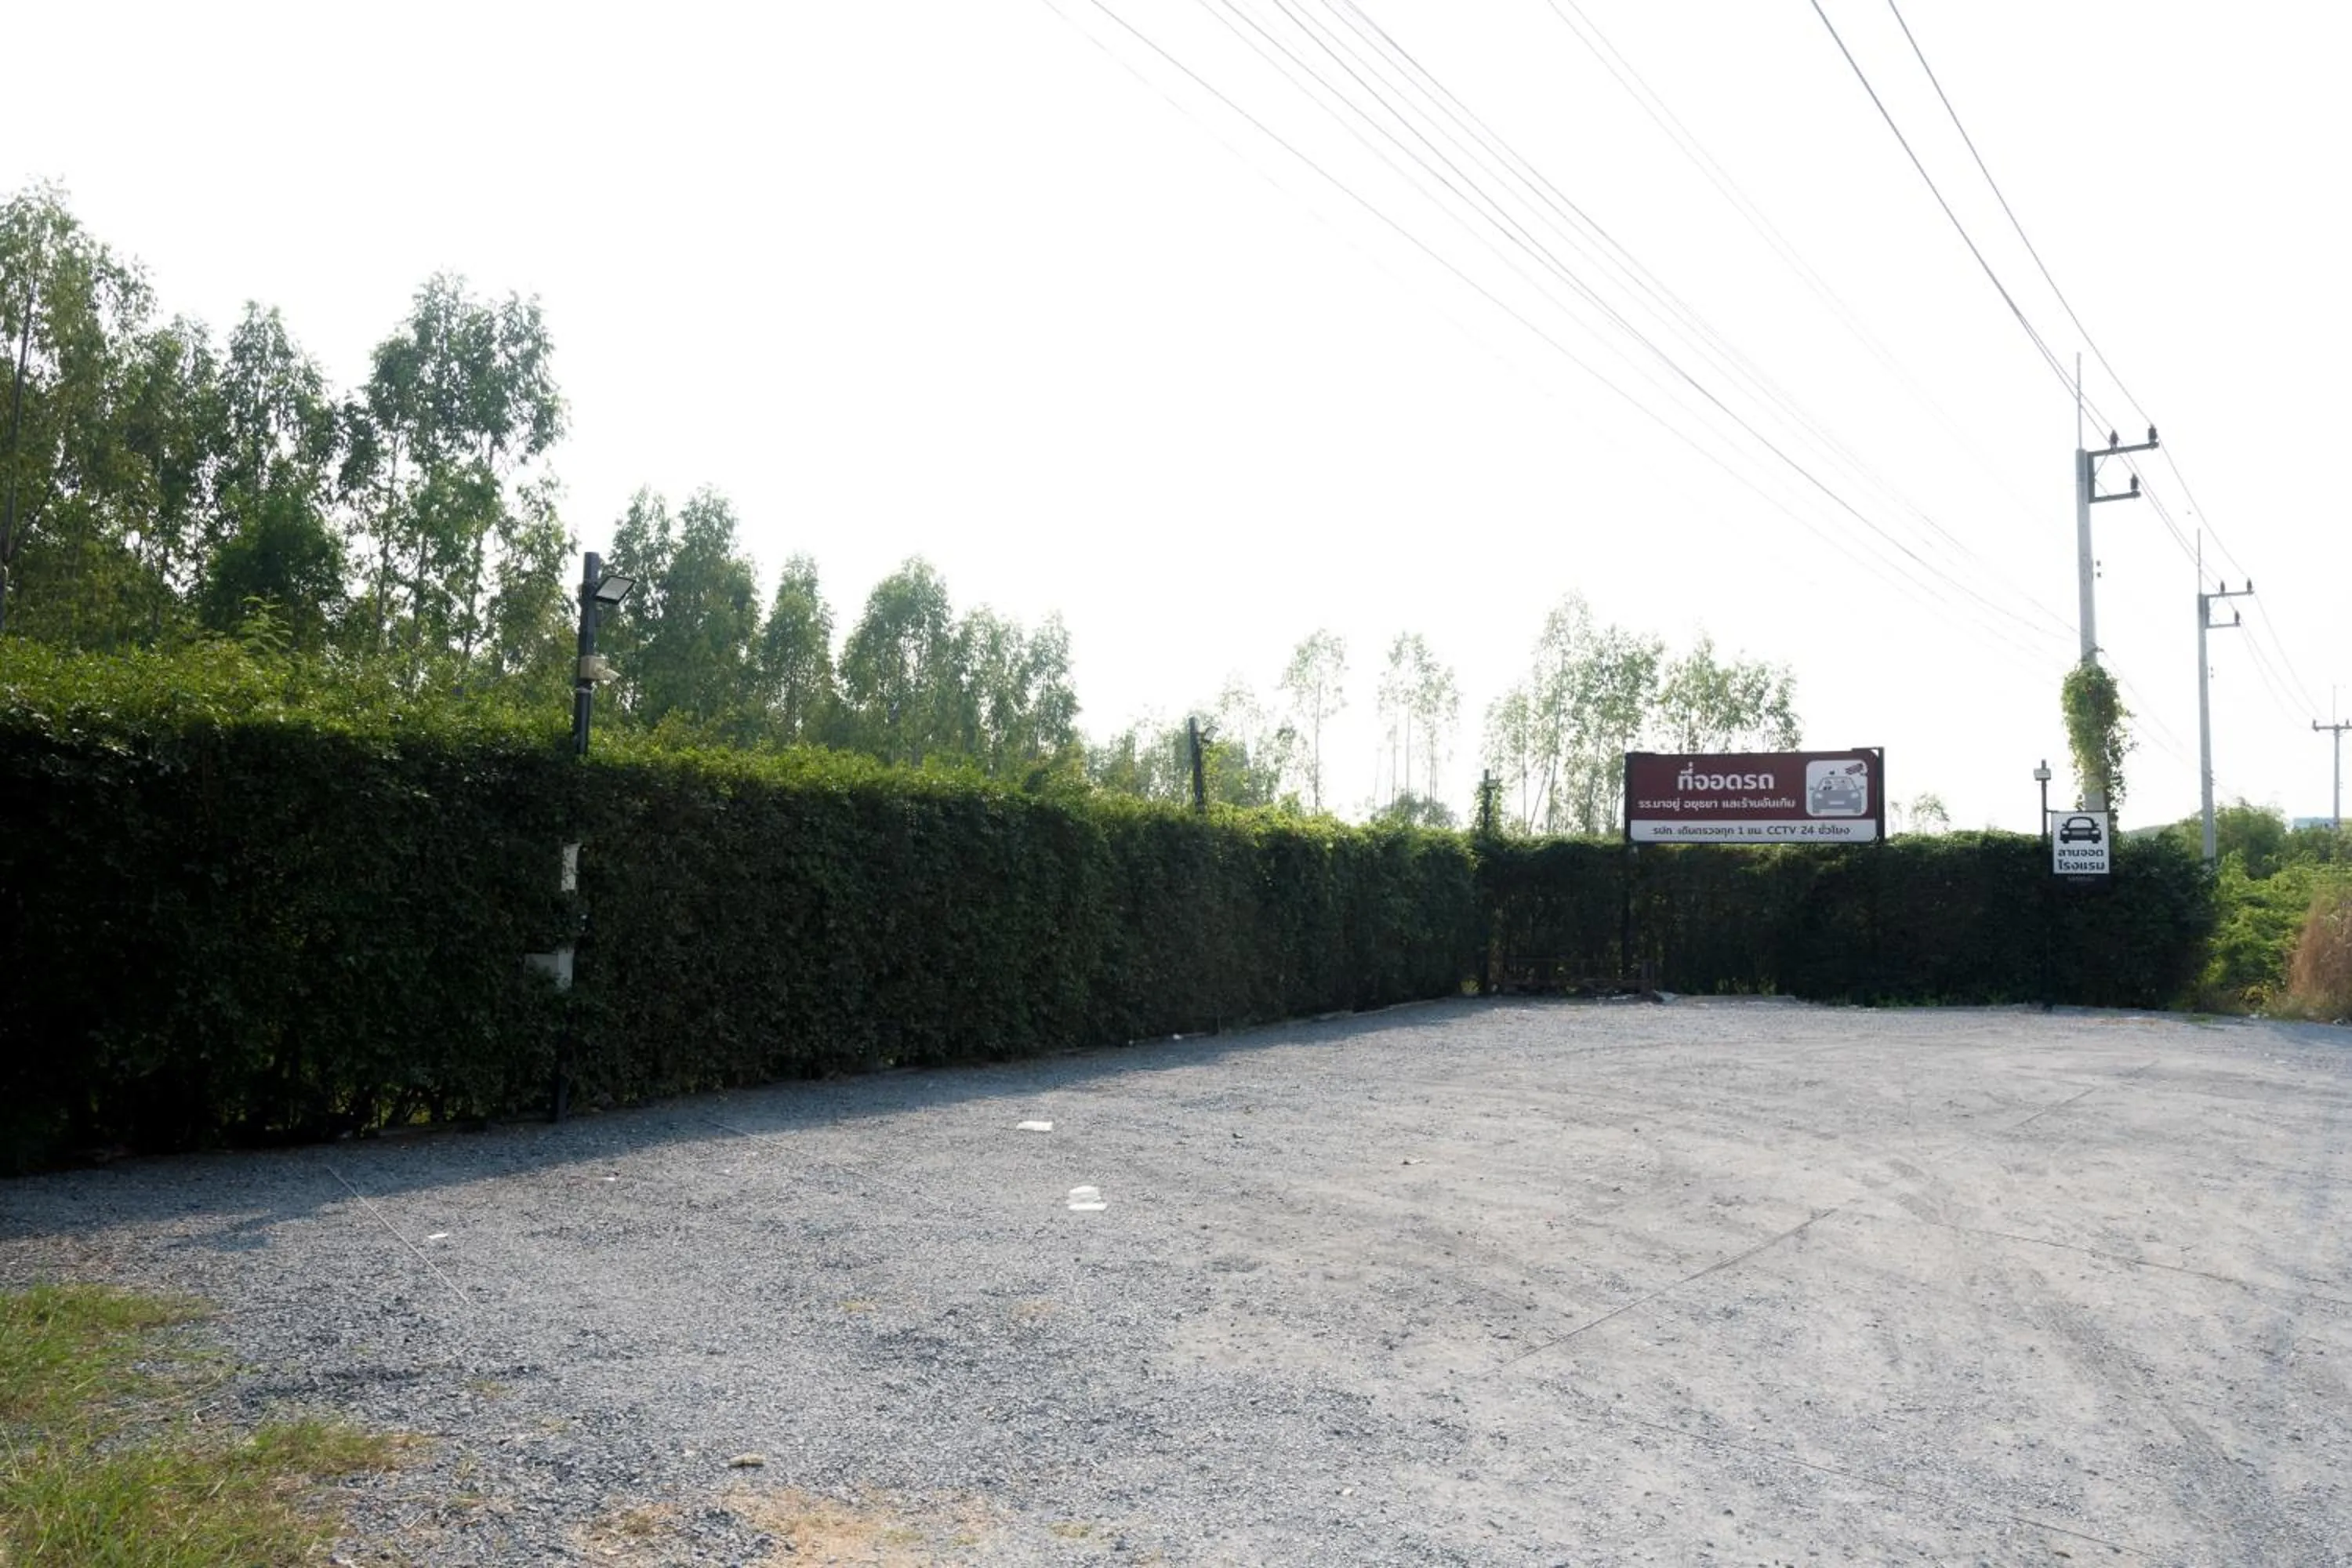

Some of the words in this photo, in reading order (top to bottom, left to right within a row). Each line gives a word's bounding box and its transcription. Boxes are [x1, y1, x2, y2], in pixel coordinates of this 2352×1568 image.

[1678, 761, 1774, 790] ที่จอดรถ
[1737, 826, 1744, 835] 1
[1766, 826, 1796, 835] CCTV
[1800, 826, 1813, 835] 24
[1818, 822, 1850, 835] ชั่วโมง
[2057, 859, 2105, 870] โรงแรม
